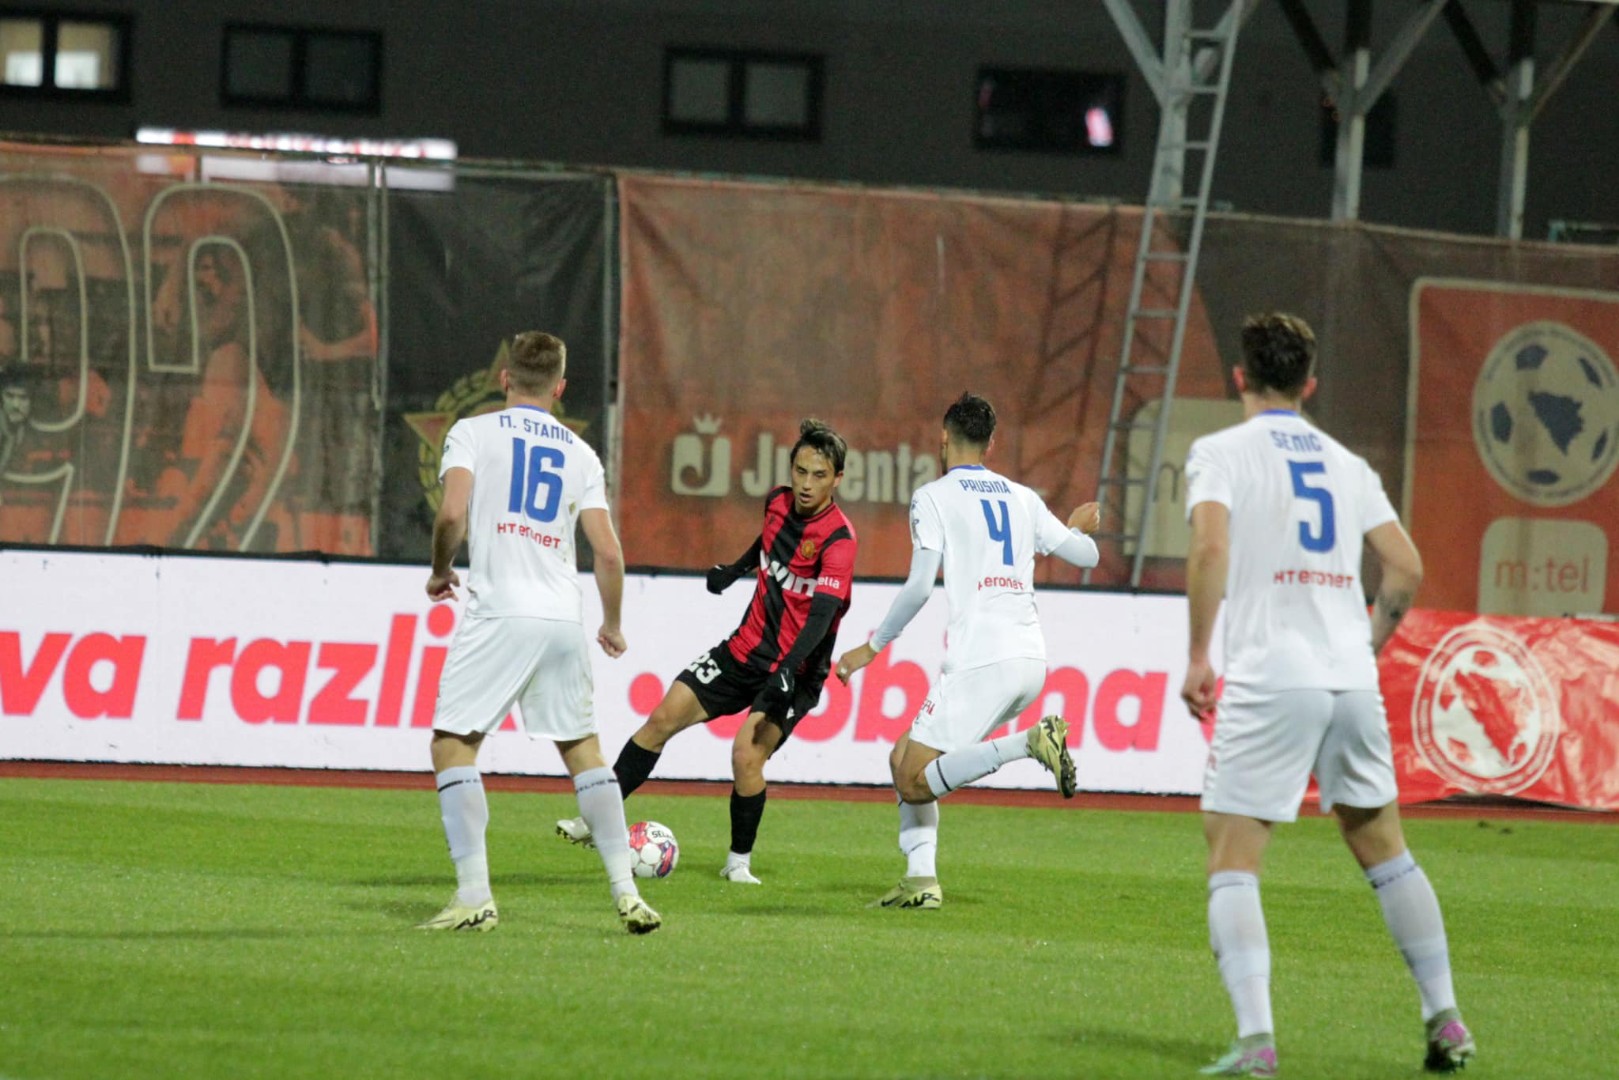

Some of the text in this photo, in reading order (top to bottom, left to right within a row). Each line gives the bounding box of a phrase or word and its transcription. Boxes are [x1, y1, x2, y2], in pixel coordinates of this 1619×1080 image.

[508, 437, 565, 523] 16
[742, 432, 937, 505] Jenta
[980, 499, 1014, 566] 4
[1287, 460, 1335, 553] 5
[1494, 557, 1591, 594] m:tel
